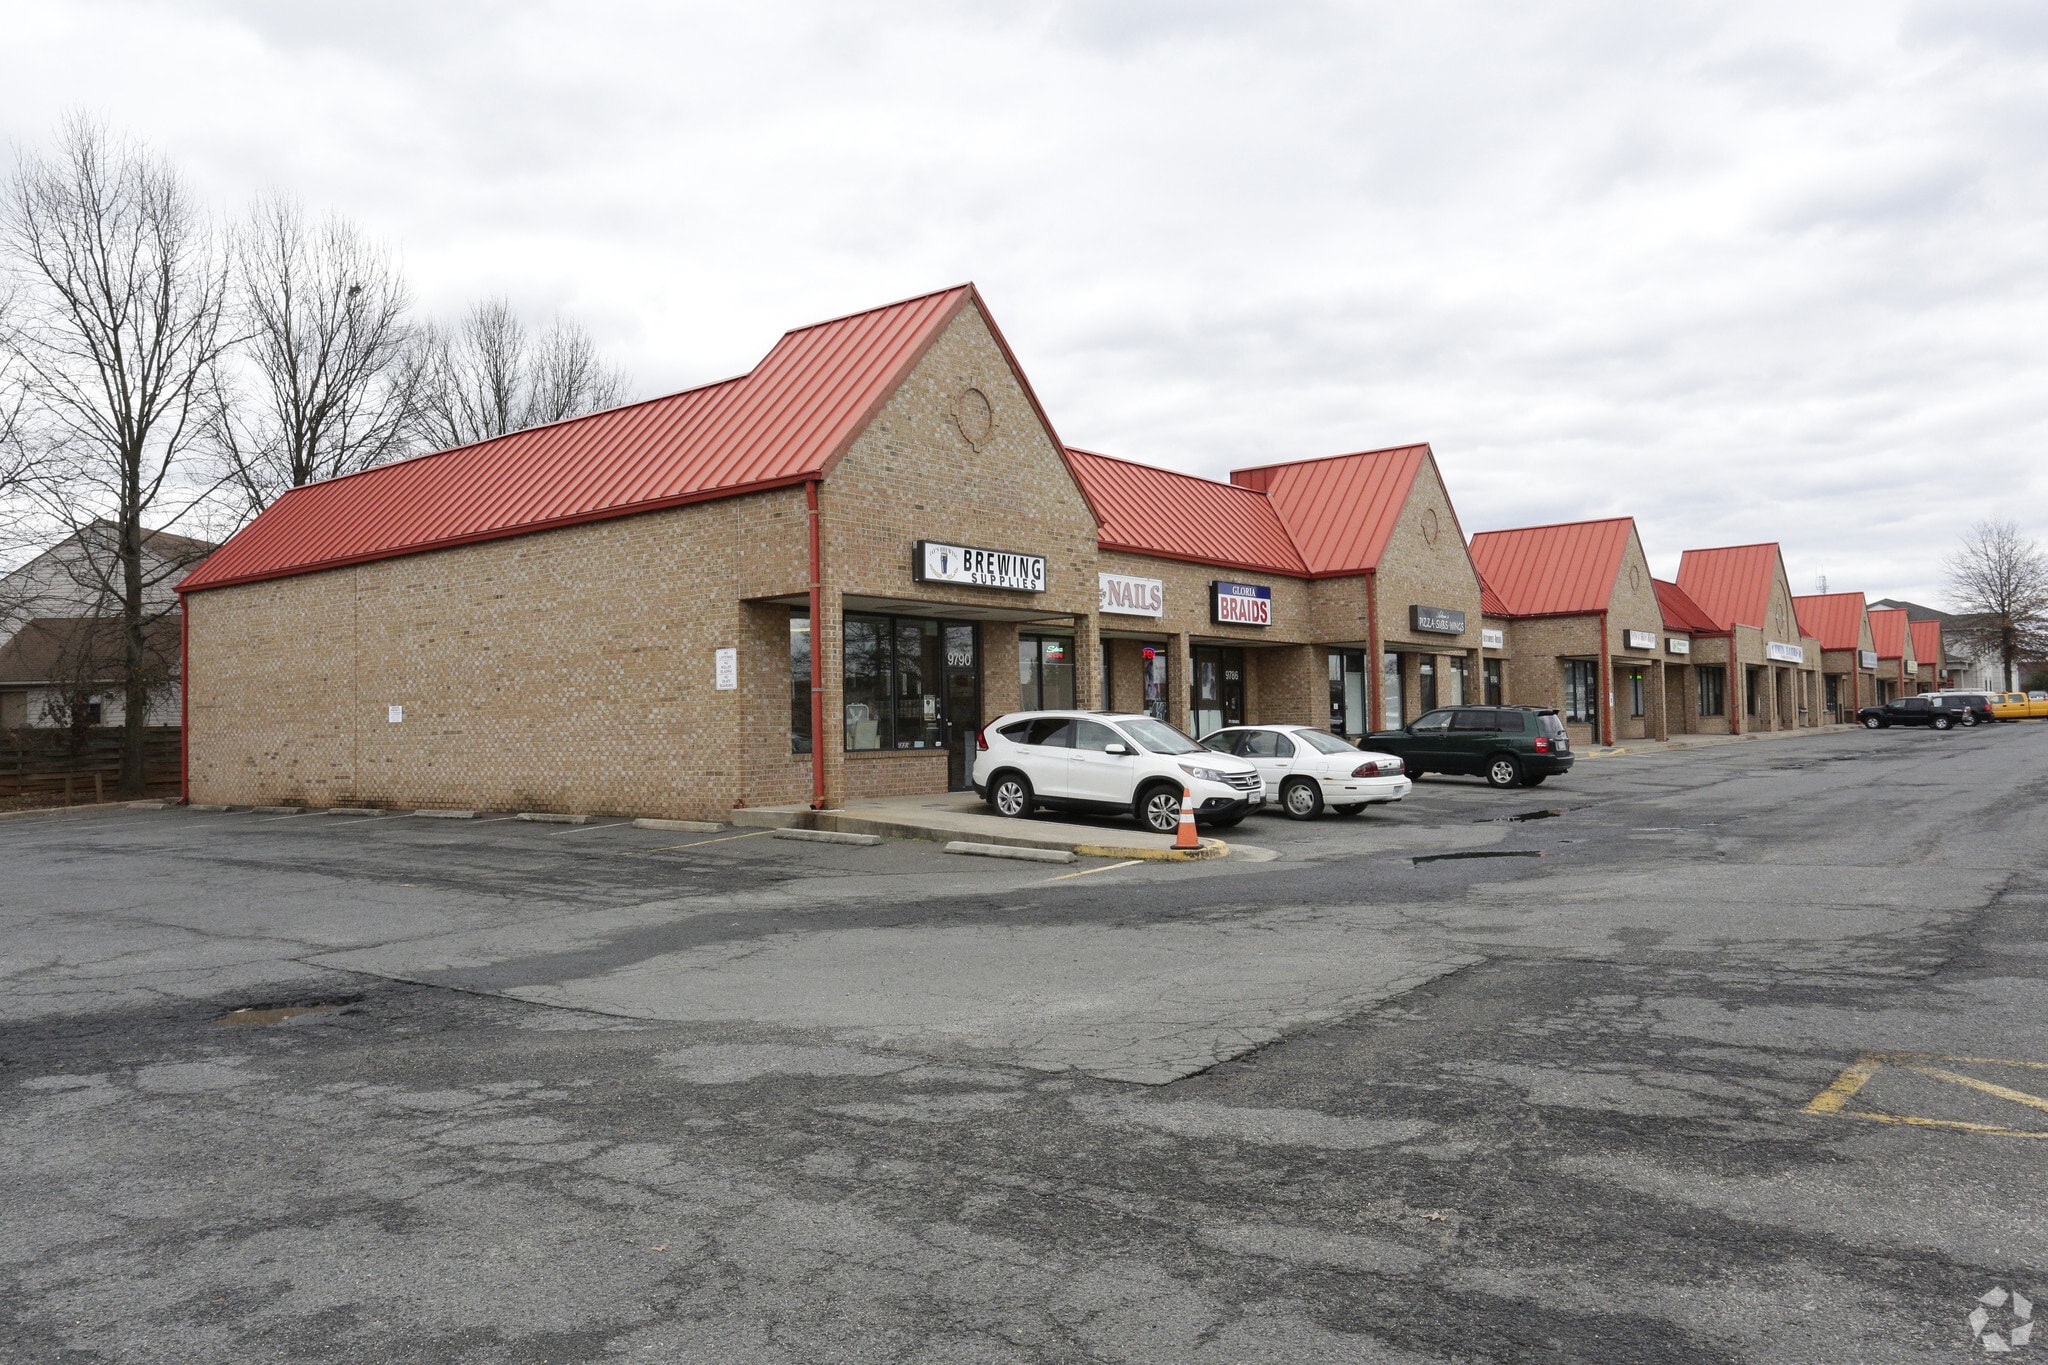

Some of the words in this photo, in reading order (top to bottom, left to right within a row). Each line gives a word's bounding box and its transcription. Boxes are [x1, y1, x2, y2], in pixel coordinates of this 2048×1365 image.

[963, 549, 1041, 580] BREWING
[971, 572, 1037, 590] SUPPLIES
[1107, 579, 1162, 611] NAILS
[1232, 585, 1256, 597] GLORIA
[1220, 596, 1268, 623] BRAIDS
[1419, 617, 1434, 629] PIZZA
[947, 652, 971, 666] 9790
